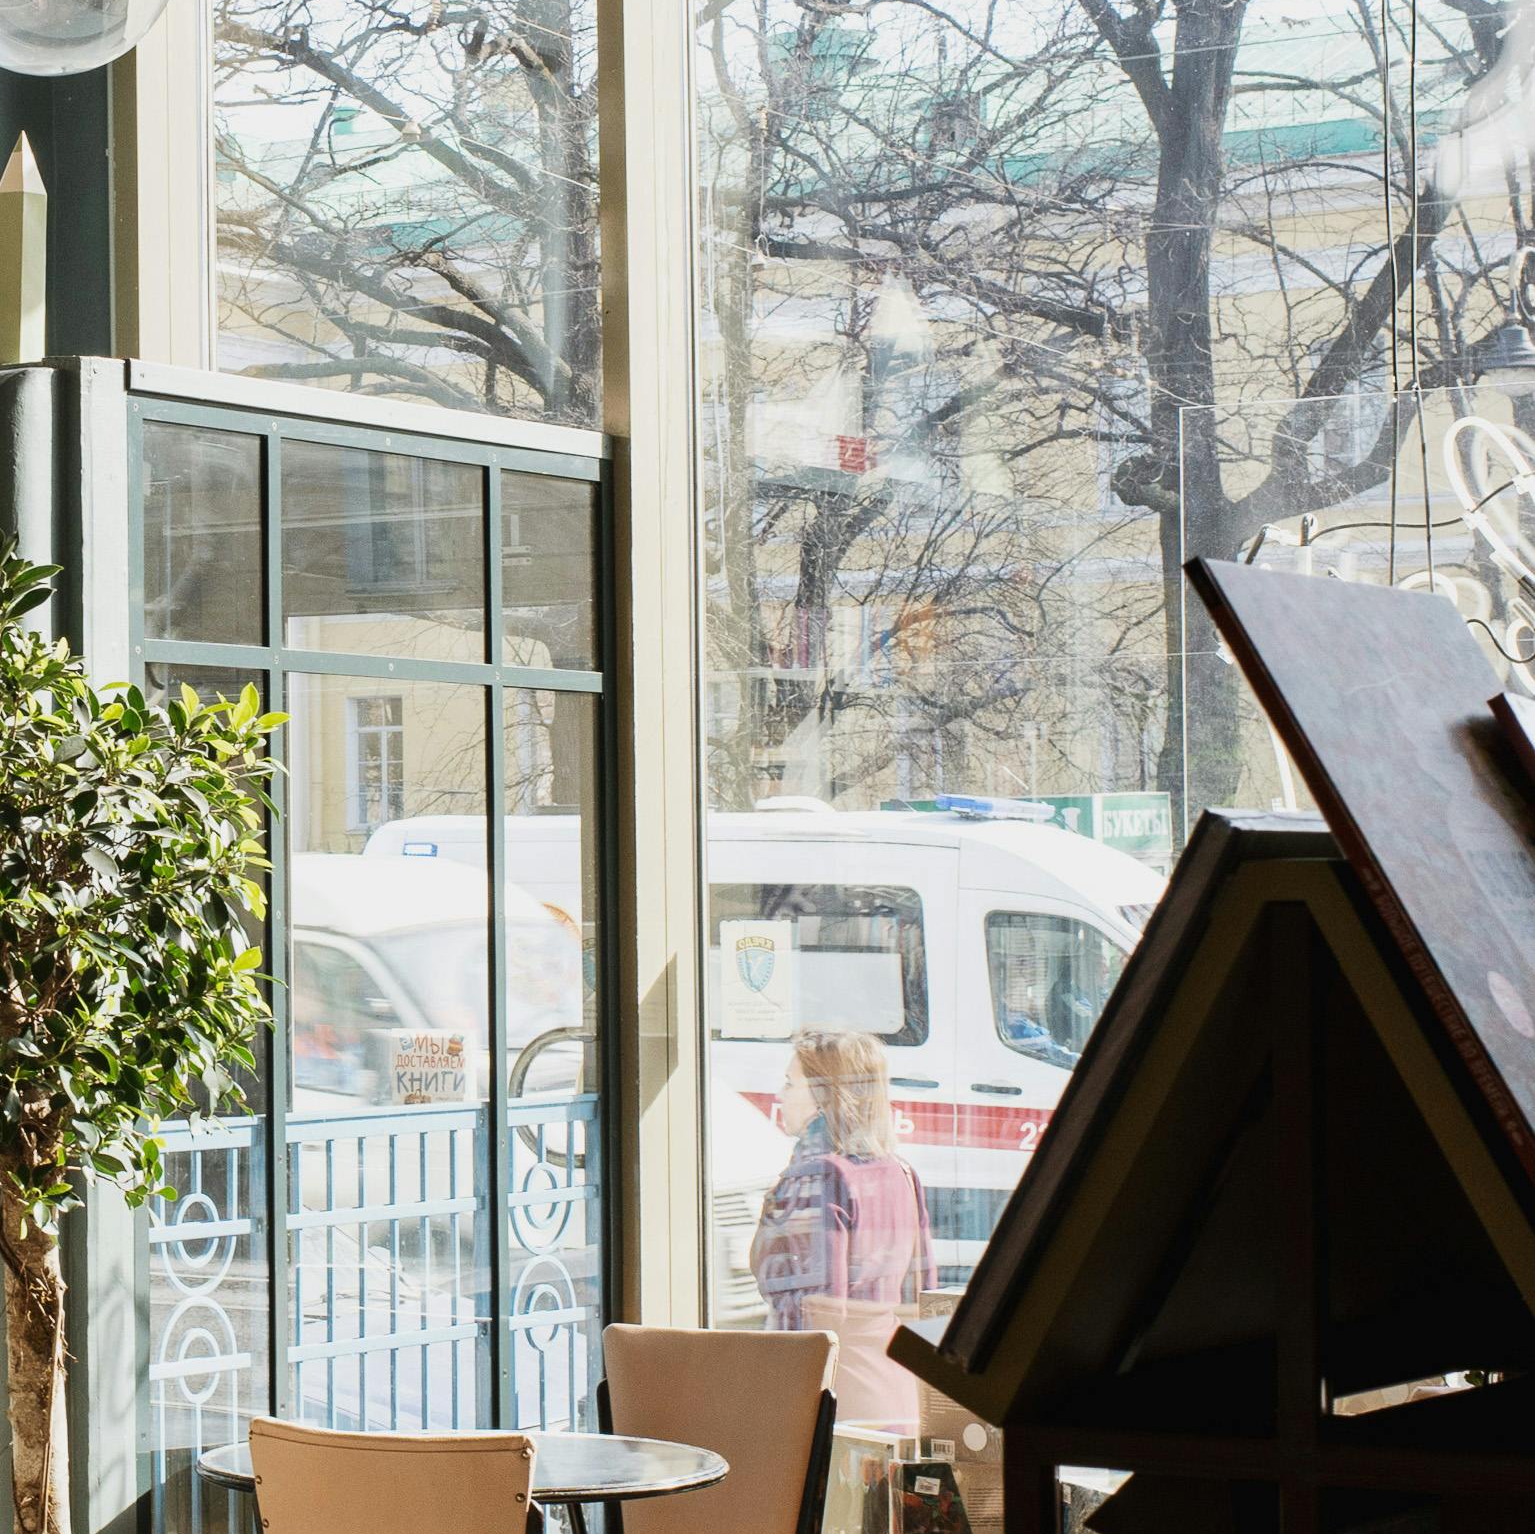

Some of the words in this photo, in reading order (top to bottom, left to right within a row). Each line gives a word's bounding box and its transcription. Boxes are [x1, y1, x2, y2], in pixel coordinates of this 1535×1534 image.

[1103, 807, 1169, 838] БУКЕТЫ
[415, 1035, 445, 1055] МЫ
[395, 1054, 466, 1070] ДОСТАВЛЯЕМ
[396, 1070, 466, 1093] КНИГИ
